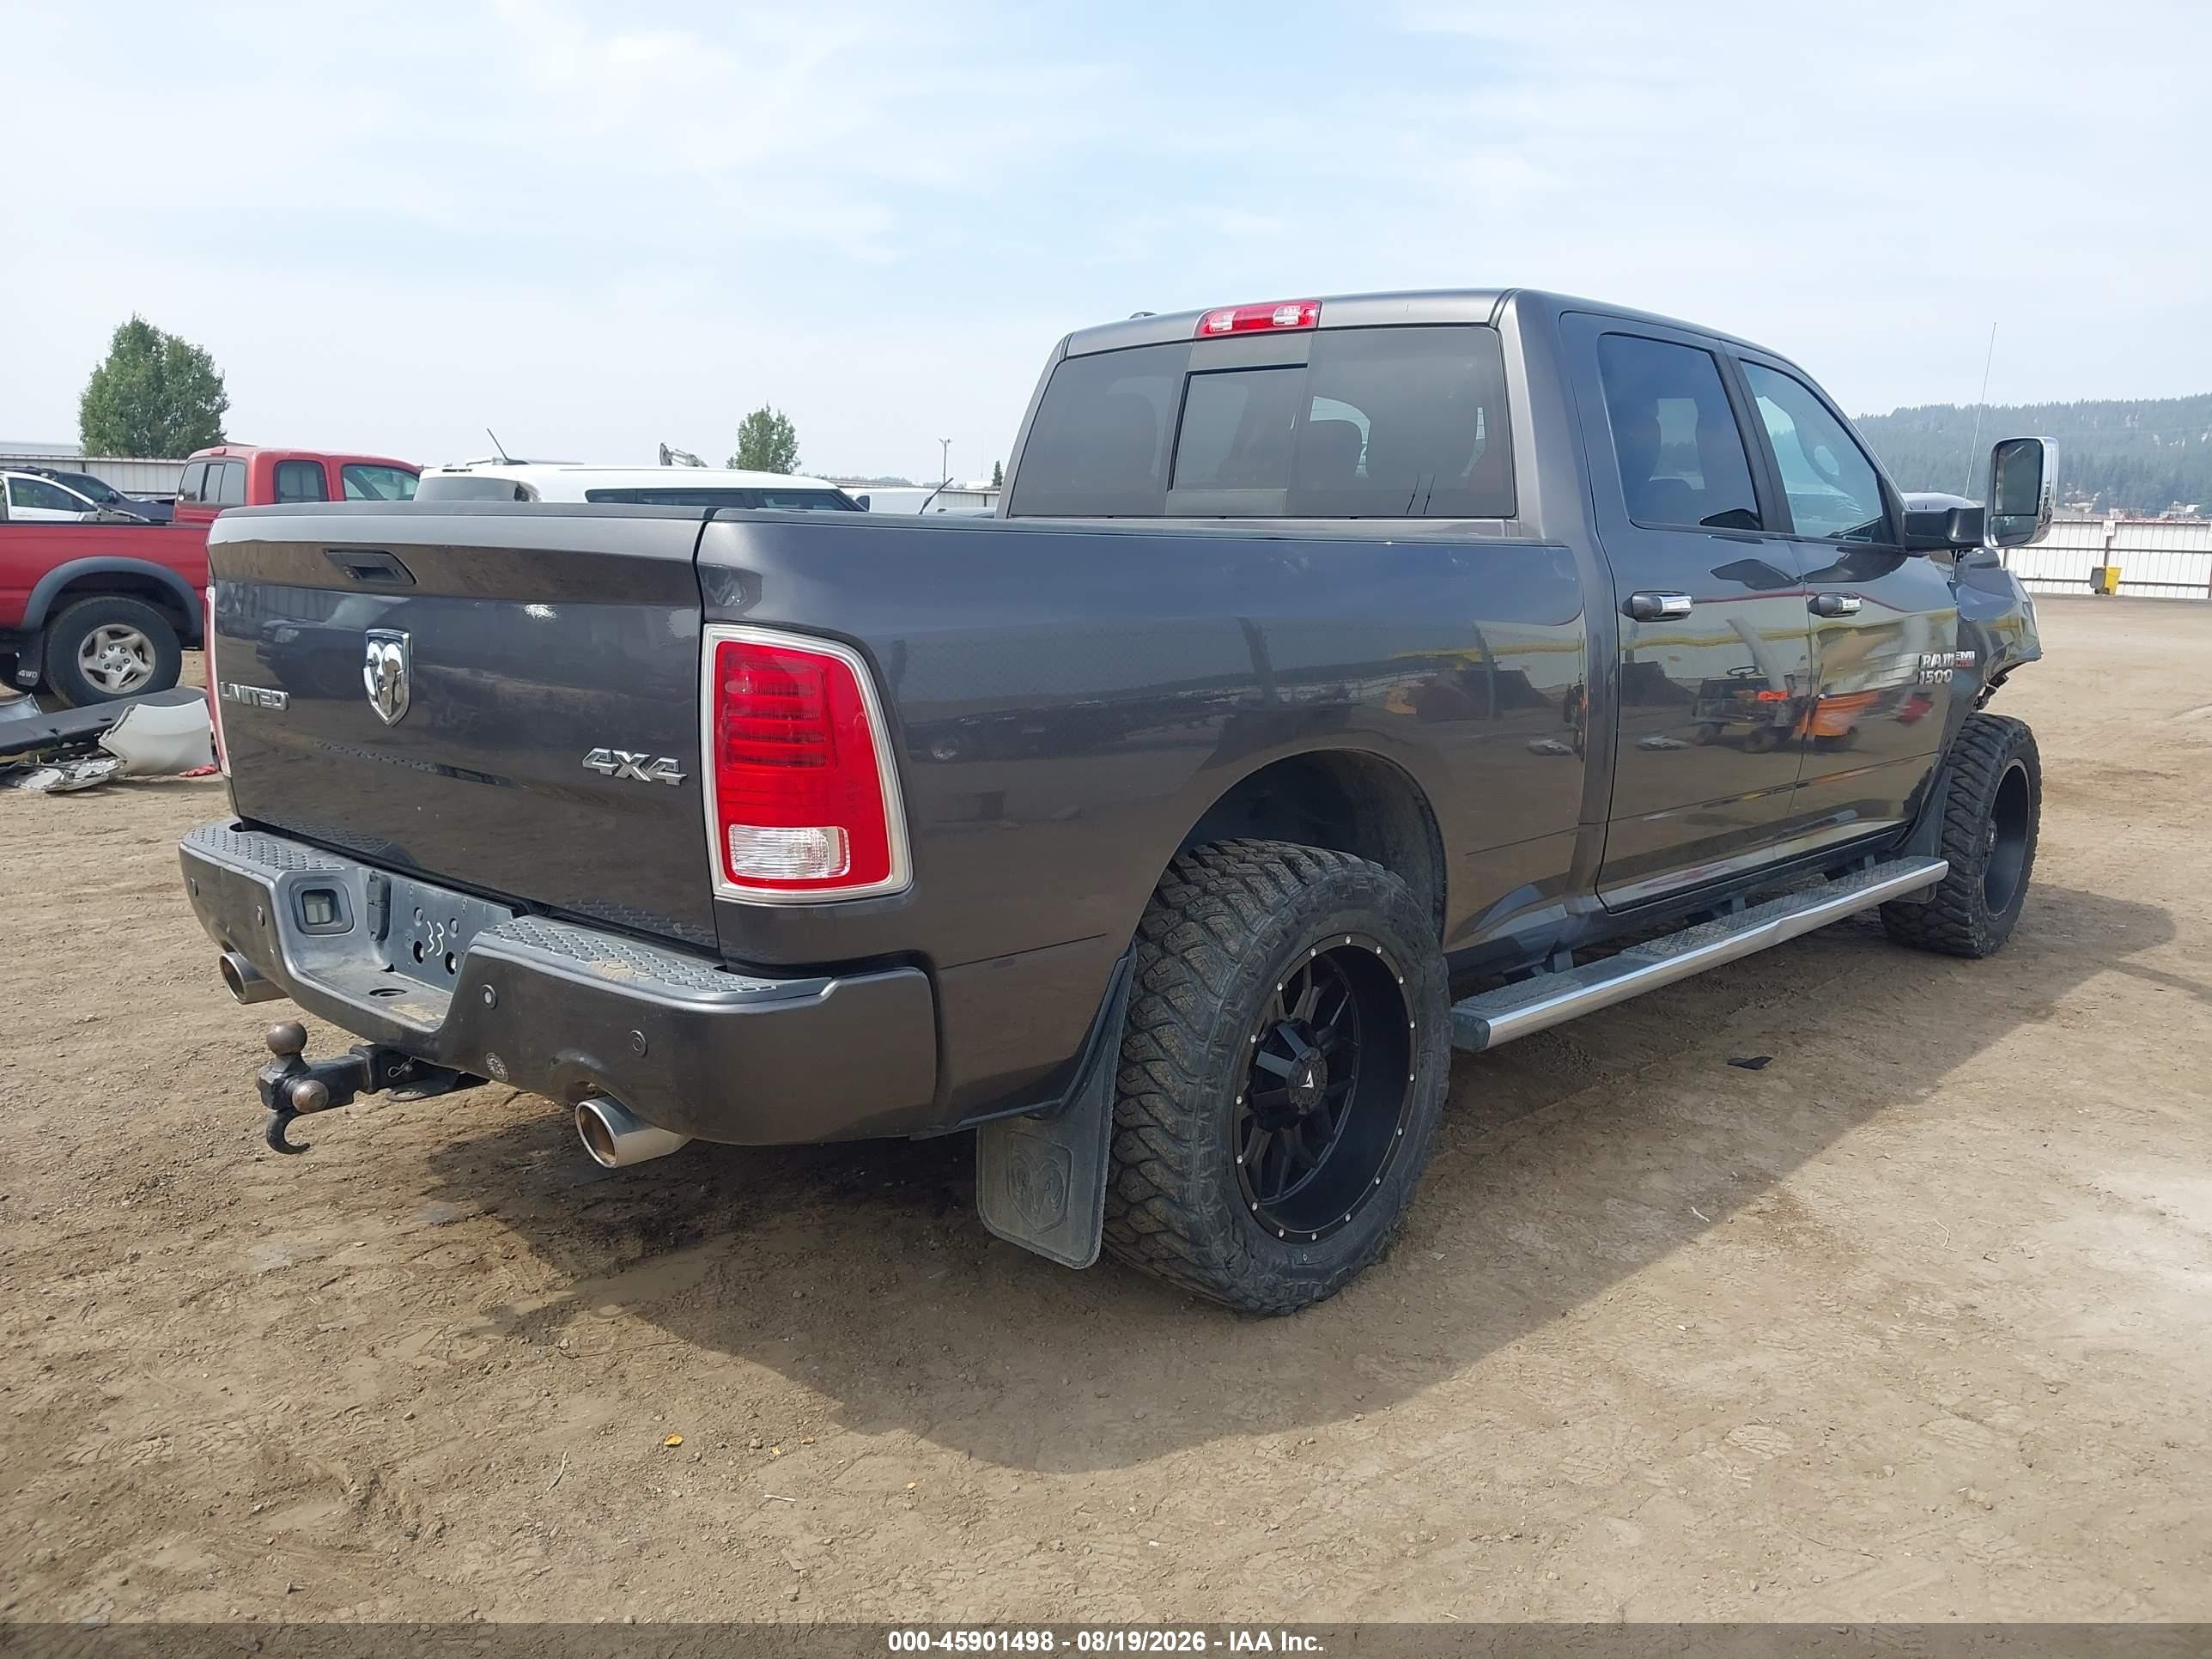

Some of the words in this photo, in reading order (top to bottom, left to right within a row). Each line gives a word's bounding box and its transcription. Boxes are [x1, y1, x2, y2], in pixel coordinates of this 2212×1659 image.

[1922, 652, 1954, 668] RAM
[1955, 650, 1976, 660] EMI
[18, 669, 38, 678] 4WD
[1918, 668, 1953, 684] 1500
[219, 681, 289, 711] LIMITED
